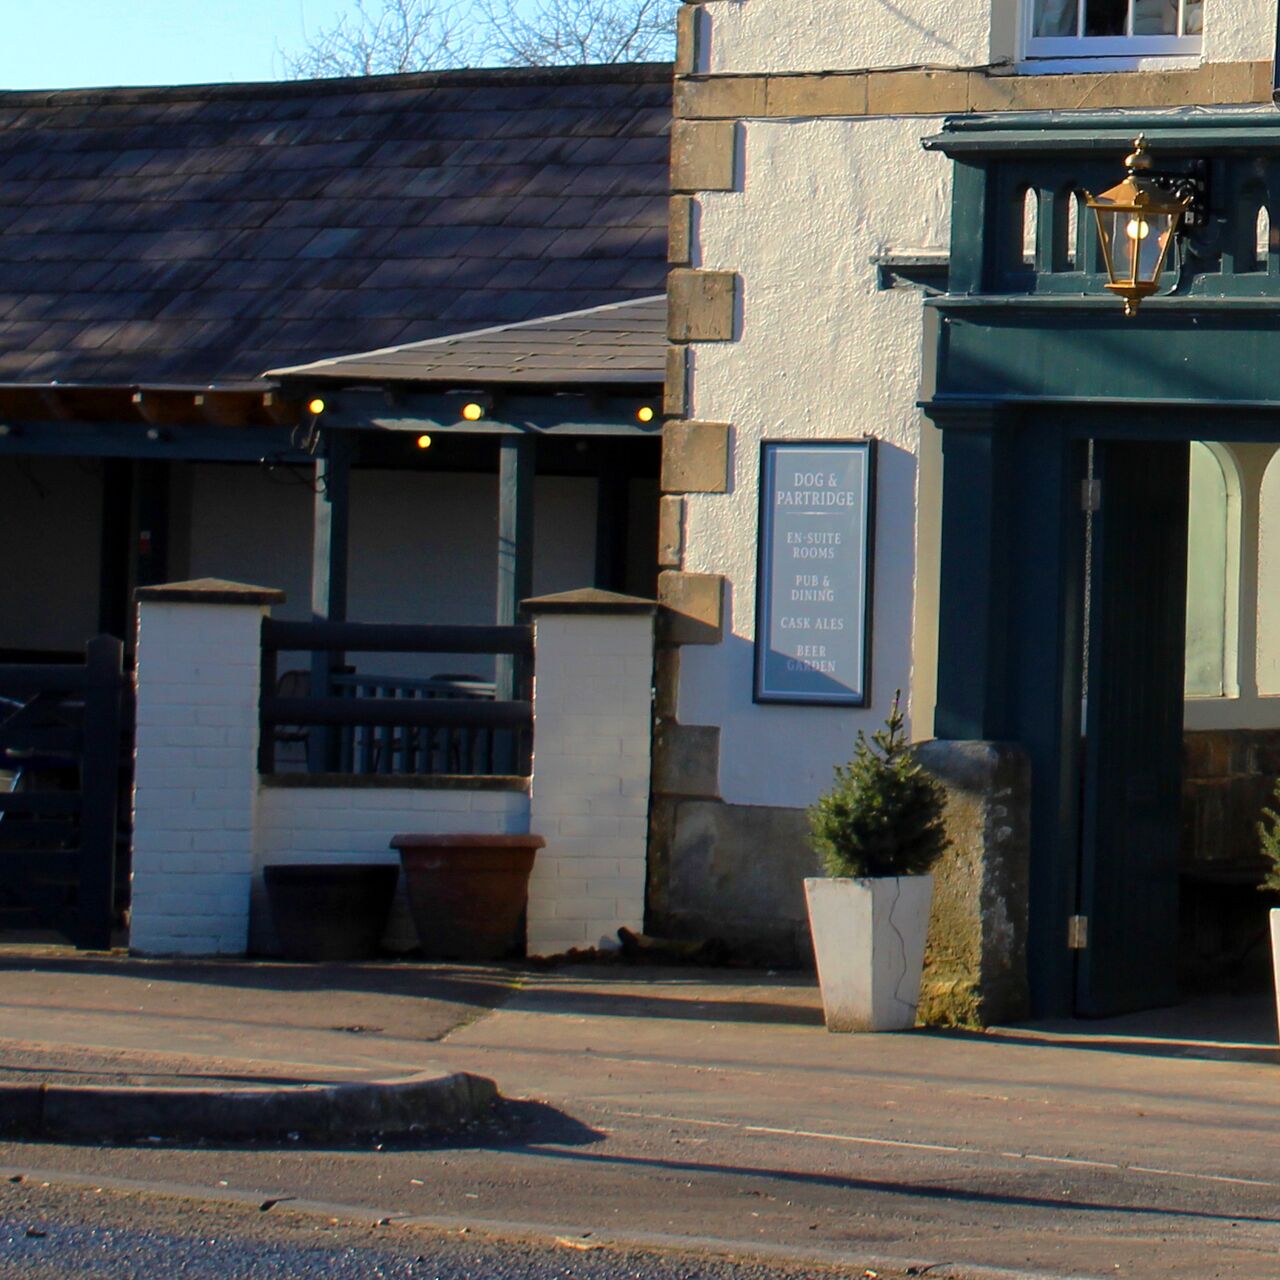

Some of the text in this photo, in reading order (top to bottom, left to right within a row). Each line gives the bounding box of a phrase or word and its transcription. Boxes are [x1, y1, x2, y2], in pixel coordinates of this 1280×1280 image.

[794, 472, 837, 488] DOG &
[776, 491, 855, 507] PARTRIDGE
[793, 547, 835, 560] ROOMS
[795, 575, 830, 587] PUB &
[791, 589, 834, 602] DINING
[780, 617, 844, 631] CASK ALES
[797, 645, 826, 657] BEER
[787, 660, 836, 672] GARDEN
